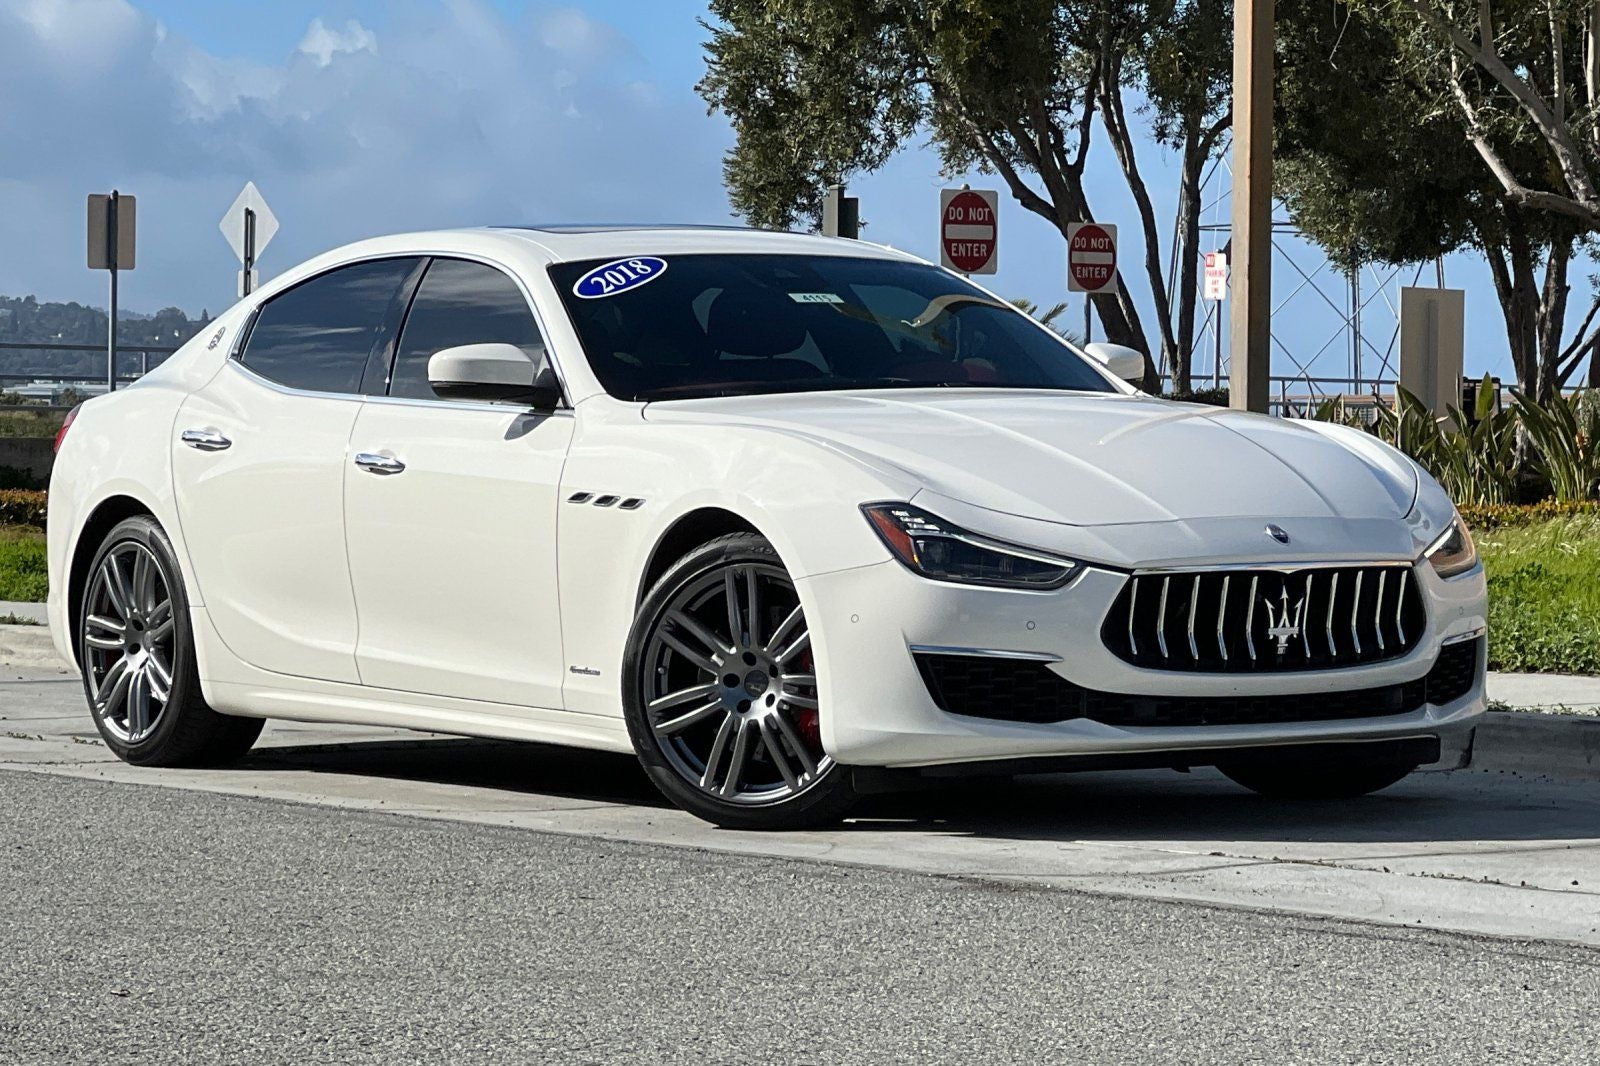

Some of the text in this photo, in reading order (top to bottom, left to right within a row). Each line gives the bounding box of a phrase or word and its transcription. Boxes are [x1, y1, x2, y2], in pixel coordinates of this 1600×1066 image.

[949, 207, 990, 221] DO NOT
[951, 243, 987, 257] ENTER
[1074, 237, 1109, 249] DO NOT
[590, 260, 652, 293] 2018
[1076, 266, 1107, 278] ENTER
